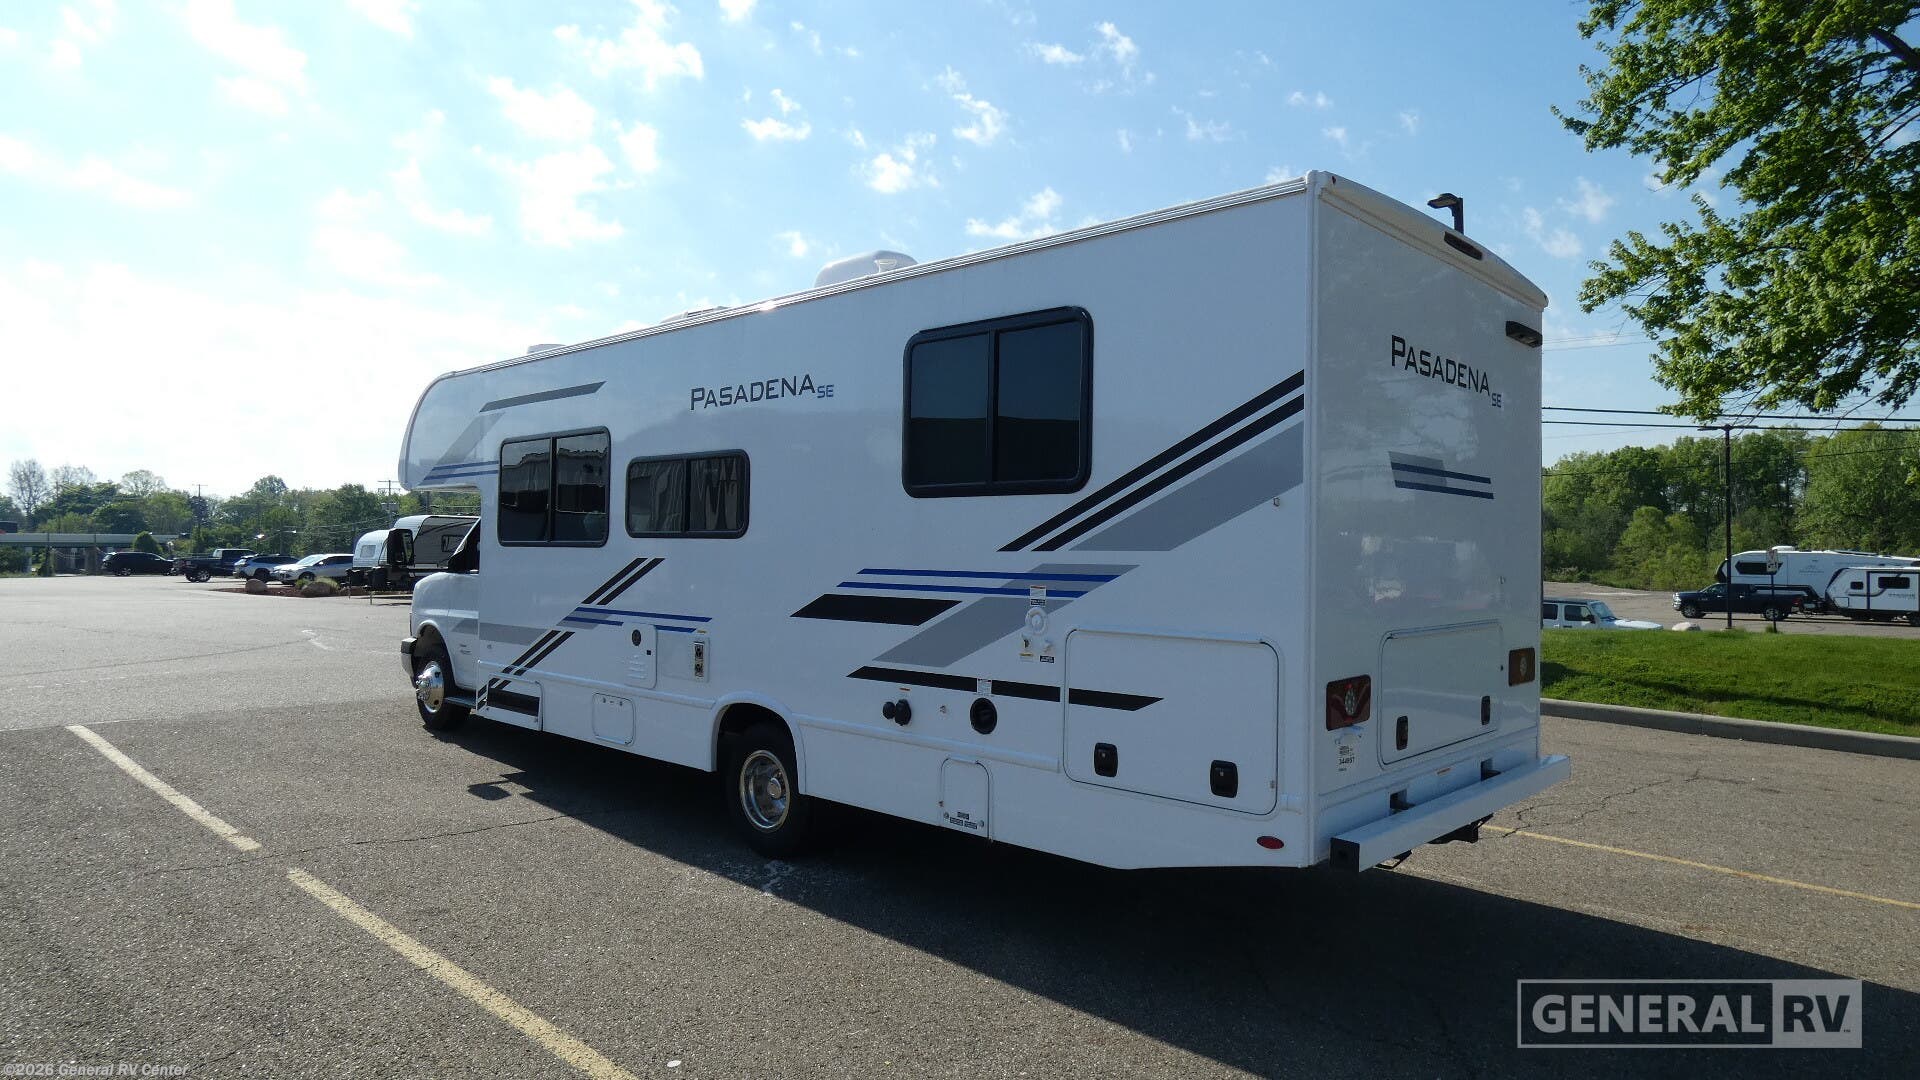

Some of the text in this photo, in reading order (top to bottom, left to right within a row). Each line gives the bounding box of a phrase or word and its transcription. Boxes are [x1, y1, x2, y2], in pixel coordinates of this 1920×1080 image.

[691, 374, 834, 411] PASADENA SE
[1391, 335, 1502, 408] PASADENA SE
